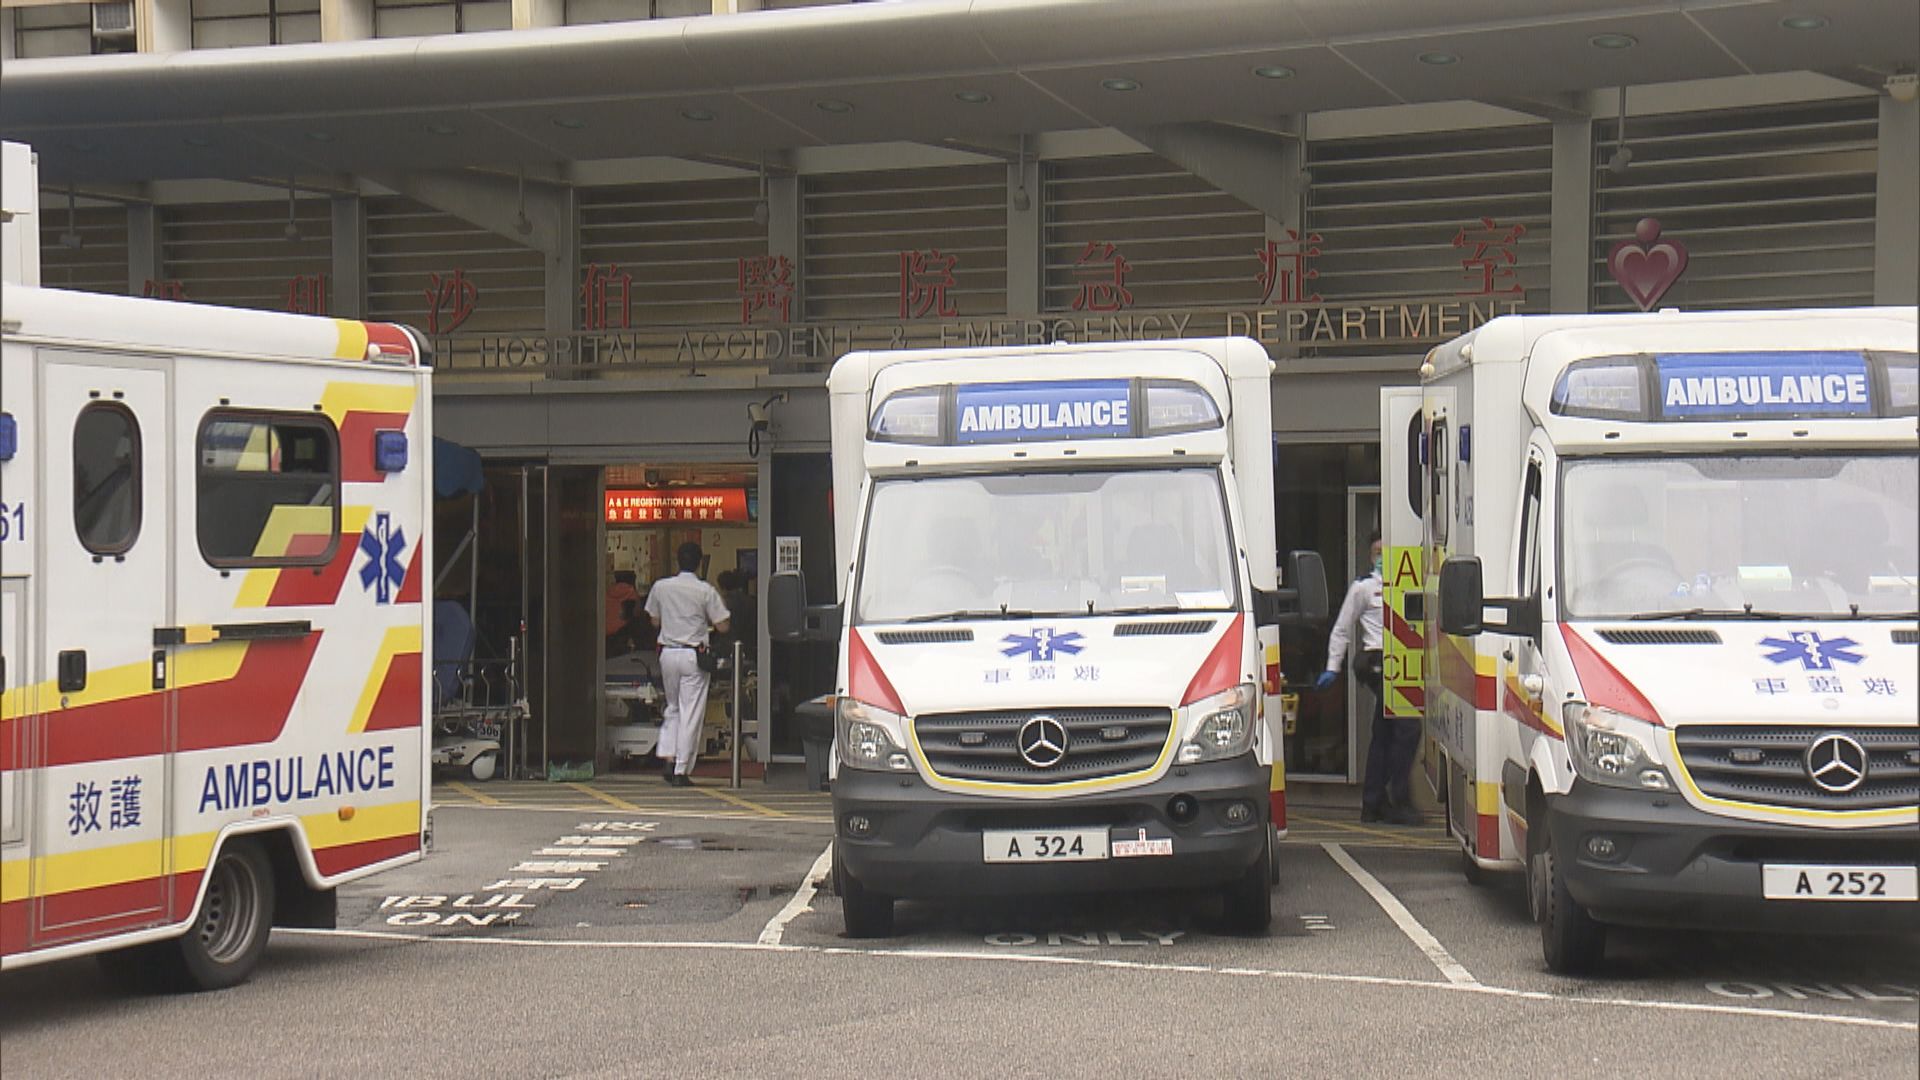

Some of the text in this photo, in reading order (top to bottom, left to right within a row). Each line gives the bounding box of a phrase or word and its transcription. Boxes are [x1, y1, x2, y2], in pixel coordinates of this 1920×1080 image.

[480, 330, 648, 368] HOSPITAL
[1666, 374, 1867, 406] AMBULANCE
[960, 400, 1128, 432] AMBULANCE
[630, 497, 684, 507] REGISTRATION
[692, 496, 724, 507] SHROFF
[199, 746, 394, 813] AMBULANCE
[68, 775, 142, 835] 救護
[1007, 835, 1084, 858] A 324
[1795, 871, 1886, 896] A 252
[983, 930, 1185, 946] ONLY
